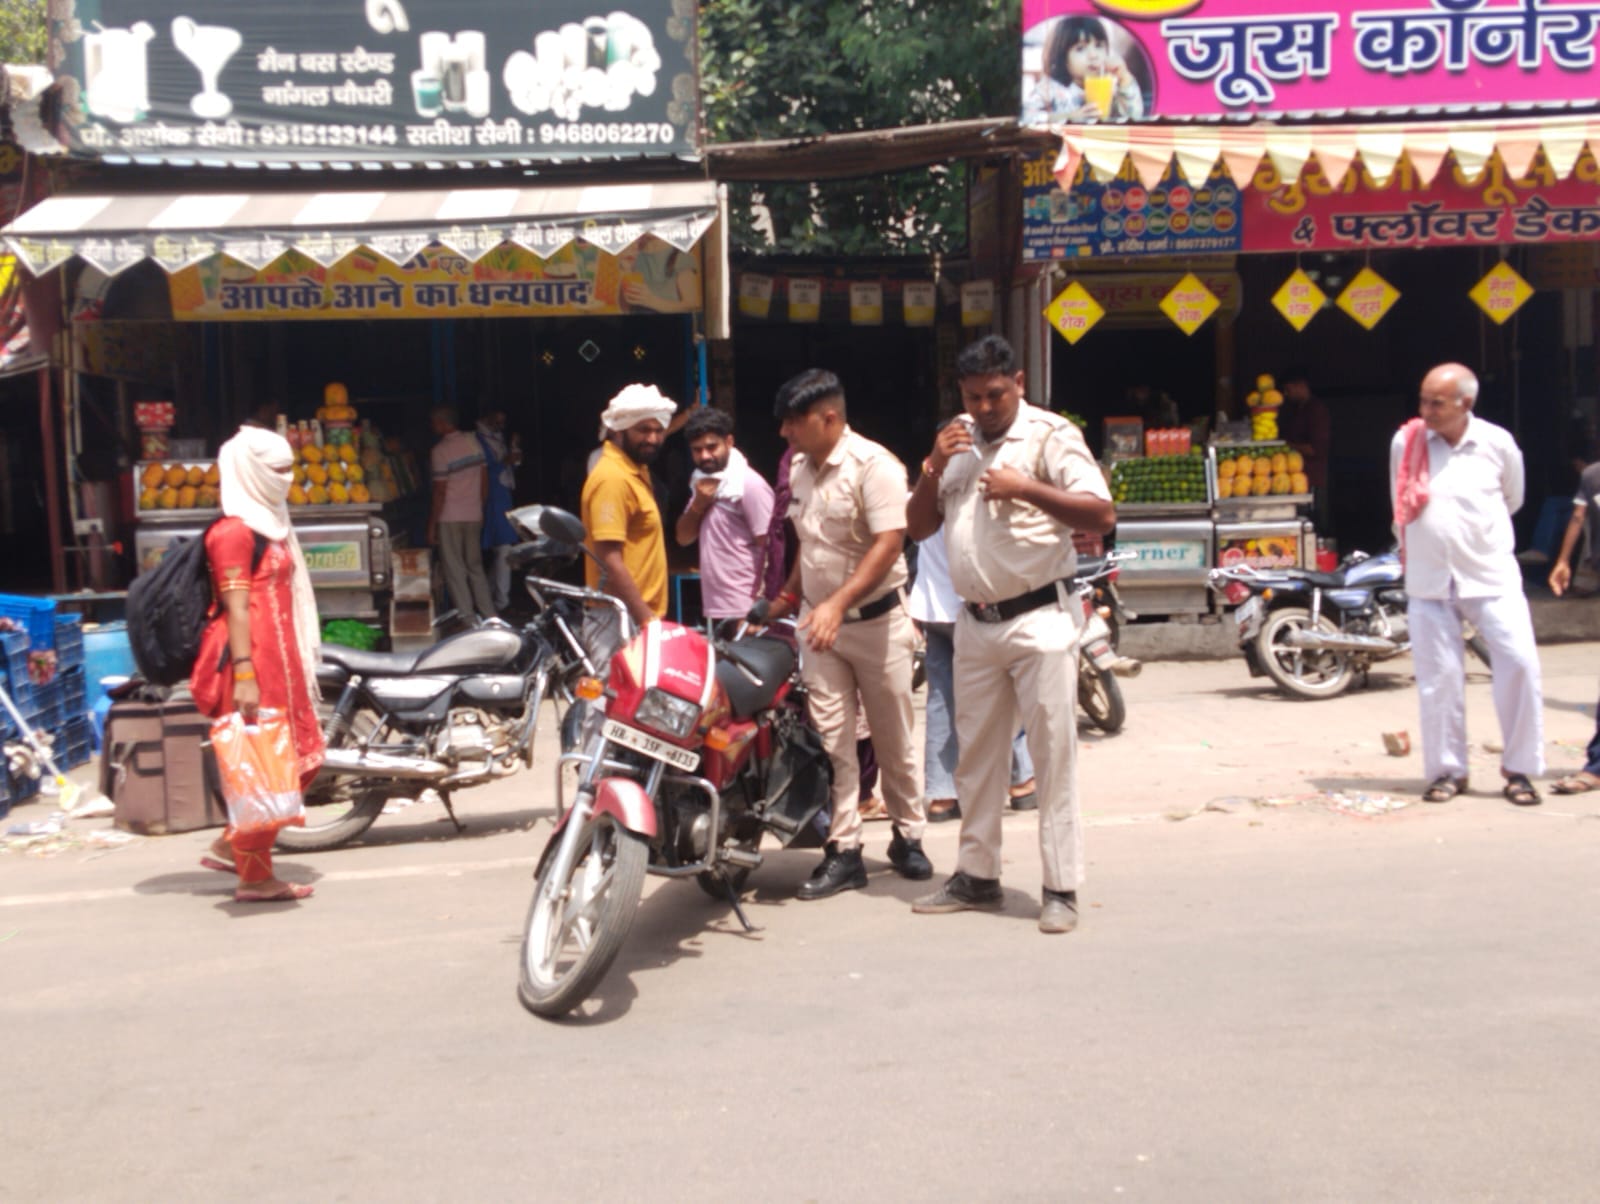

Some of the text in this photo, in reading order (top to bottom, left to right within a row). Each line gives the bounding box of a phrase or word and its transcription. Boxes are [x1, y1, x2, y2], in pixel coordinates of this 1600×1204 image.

[1163, 0, 1600, 102] जूस कॉर्नर
[405, 117, 471, 145] सतीश
[474, 117, 521, 145] सैनी
[539, 122, 675, 145] 9468062270
[1293, 216, 1317, 246] &
[1332, 202, 1503, 243] फ्लॉवर
[222, 276, 593, 310] आपके आने का धन्यवाद
[1060, 313, 1087, 329] शेक
[303, 551, 357, 569] orner
